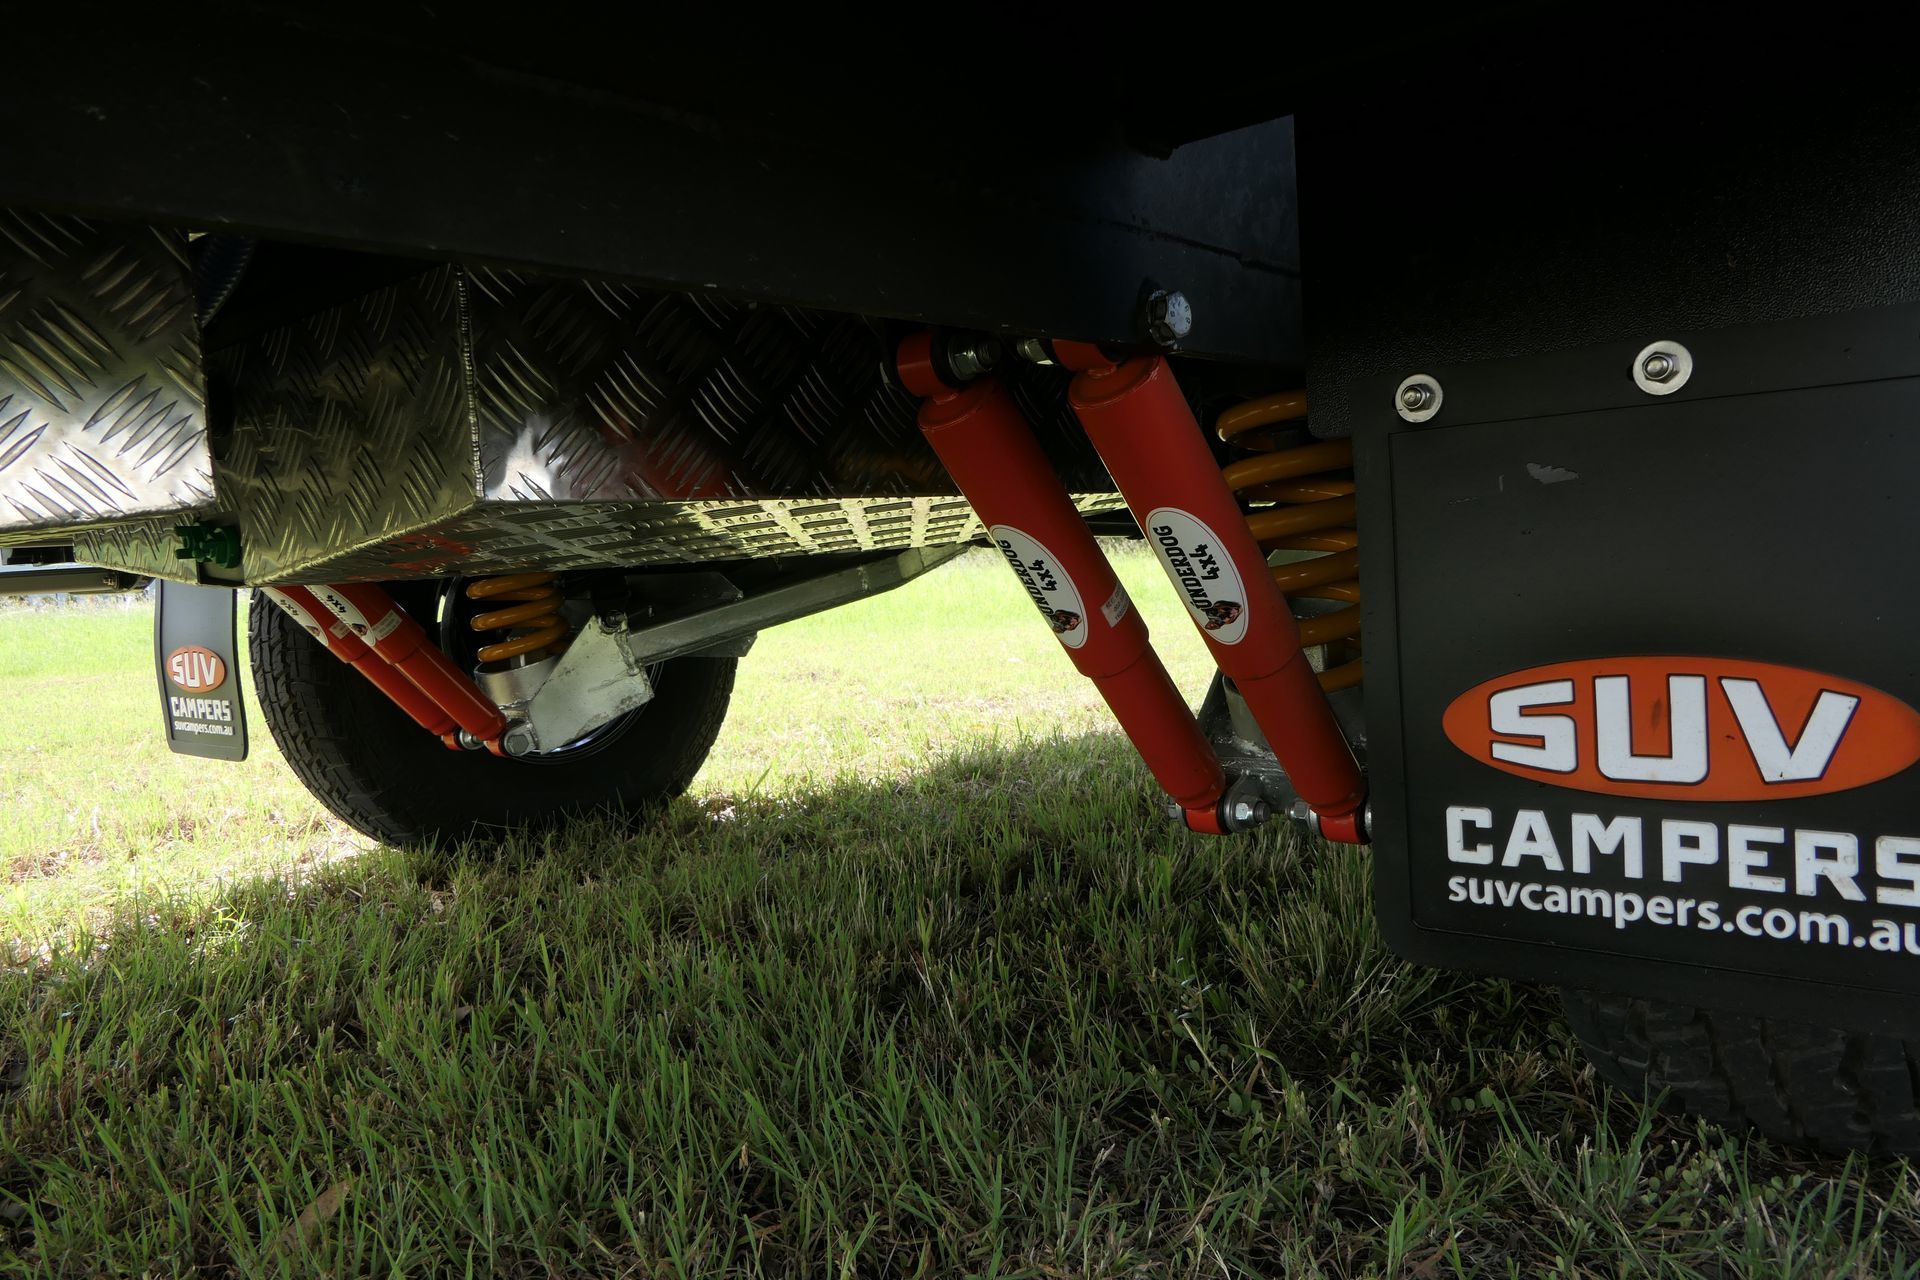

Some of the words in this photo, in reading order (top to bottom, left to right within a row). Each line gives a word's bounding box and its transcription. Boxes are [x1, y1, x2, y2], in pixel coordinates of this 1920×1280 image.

[996, 539, 1056, 618] UNDERDOG
[1152, 525, 1214, 613] UNDERDOG
[170, 696, 232, 722] CAMPERS
[171, 651, 217, 688] SUV
[174, 720, 234, 736] suvcampers.com.au
[1489, 673, 1861, 786] SUV
[1445, 804, 1920, 908] CAMPERS
